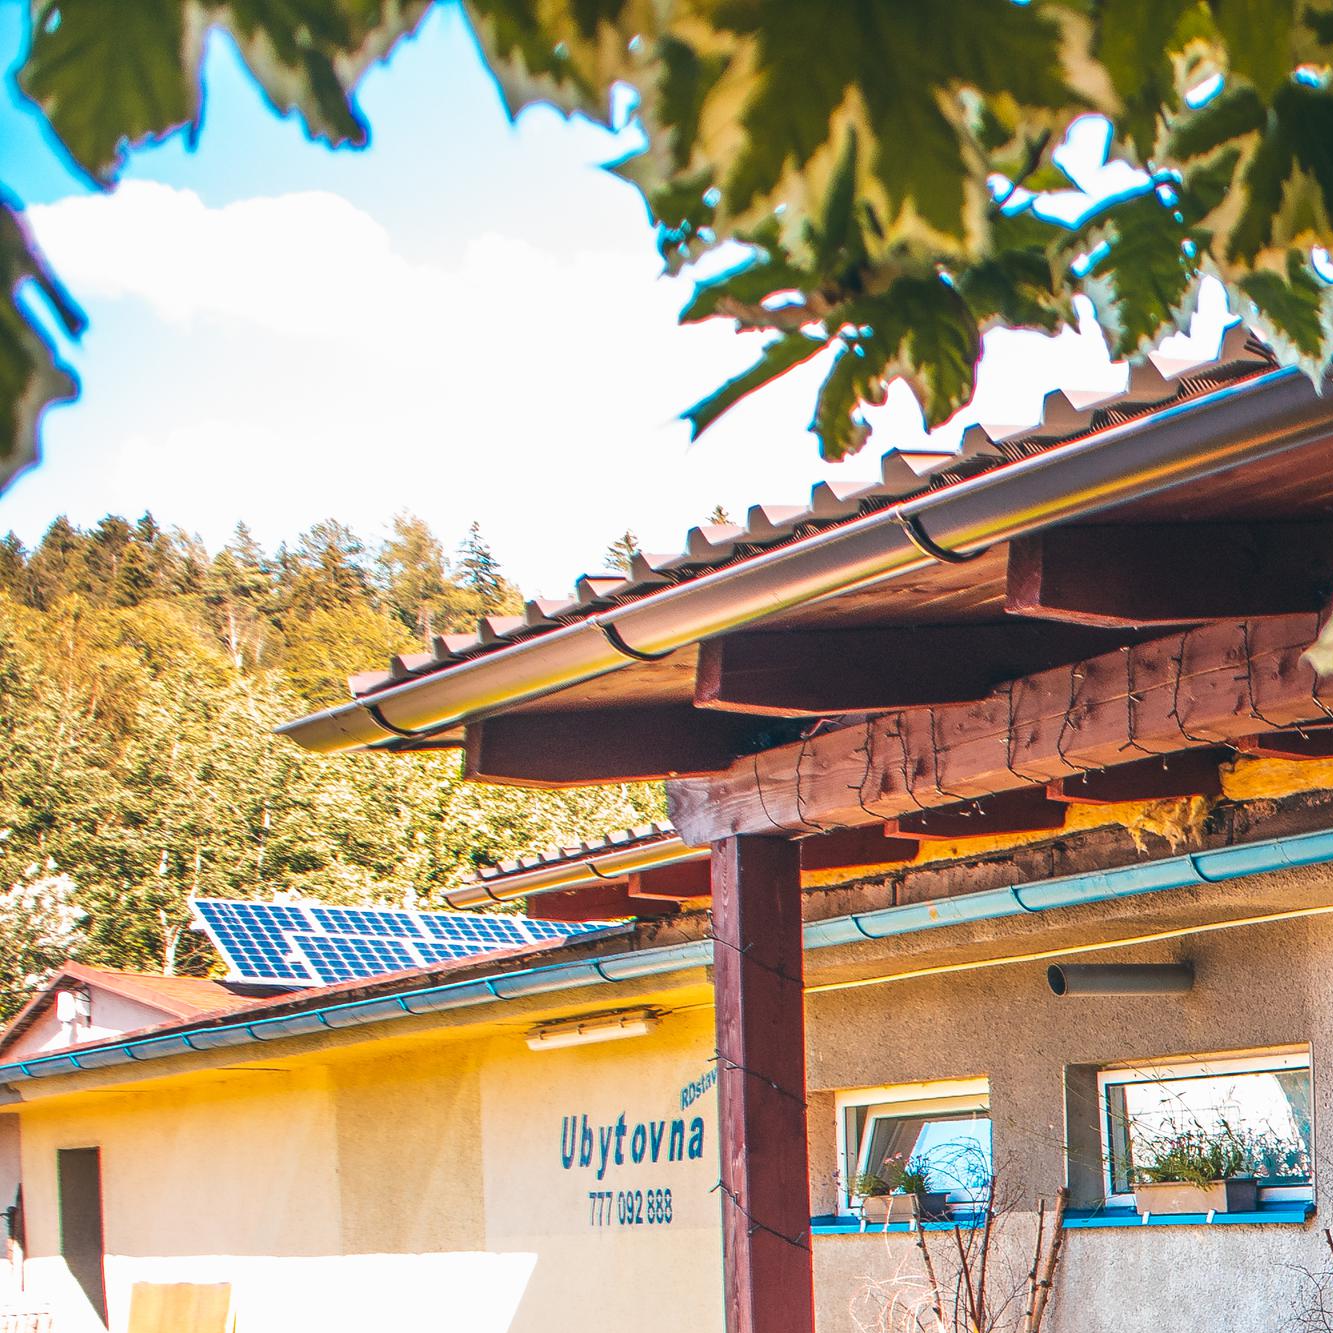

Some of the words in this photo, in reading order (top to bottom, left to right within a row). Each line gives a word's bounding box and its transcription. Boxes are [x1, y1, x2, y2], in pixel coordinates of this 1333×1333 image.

[561, 1111, 705, 1180] Ubytovna
[588, 1191, 613, 1226] 777
[617, 1190, 643, 1225] 092
[647, 1188, 673, 1224] 888
